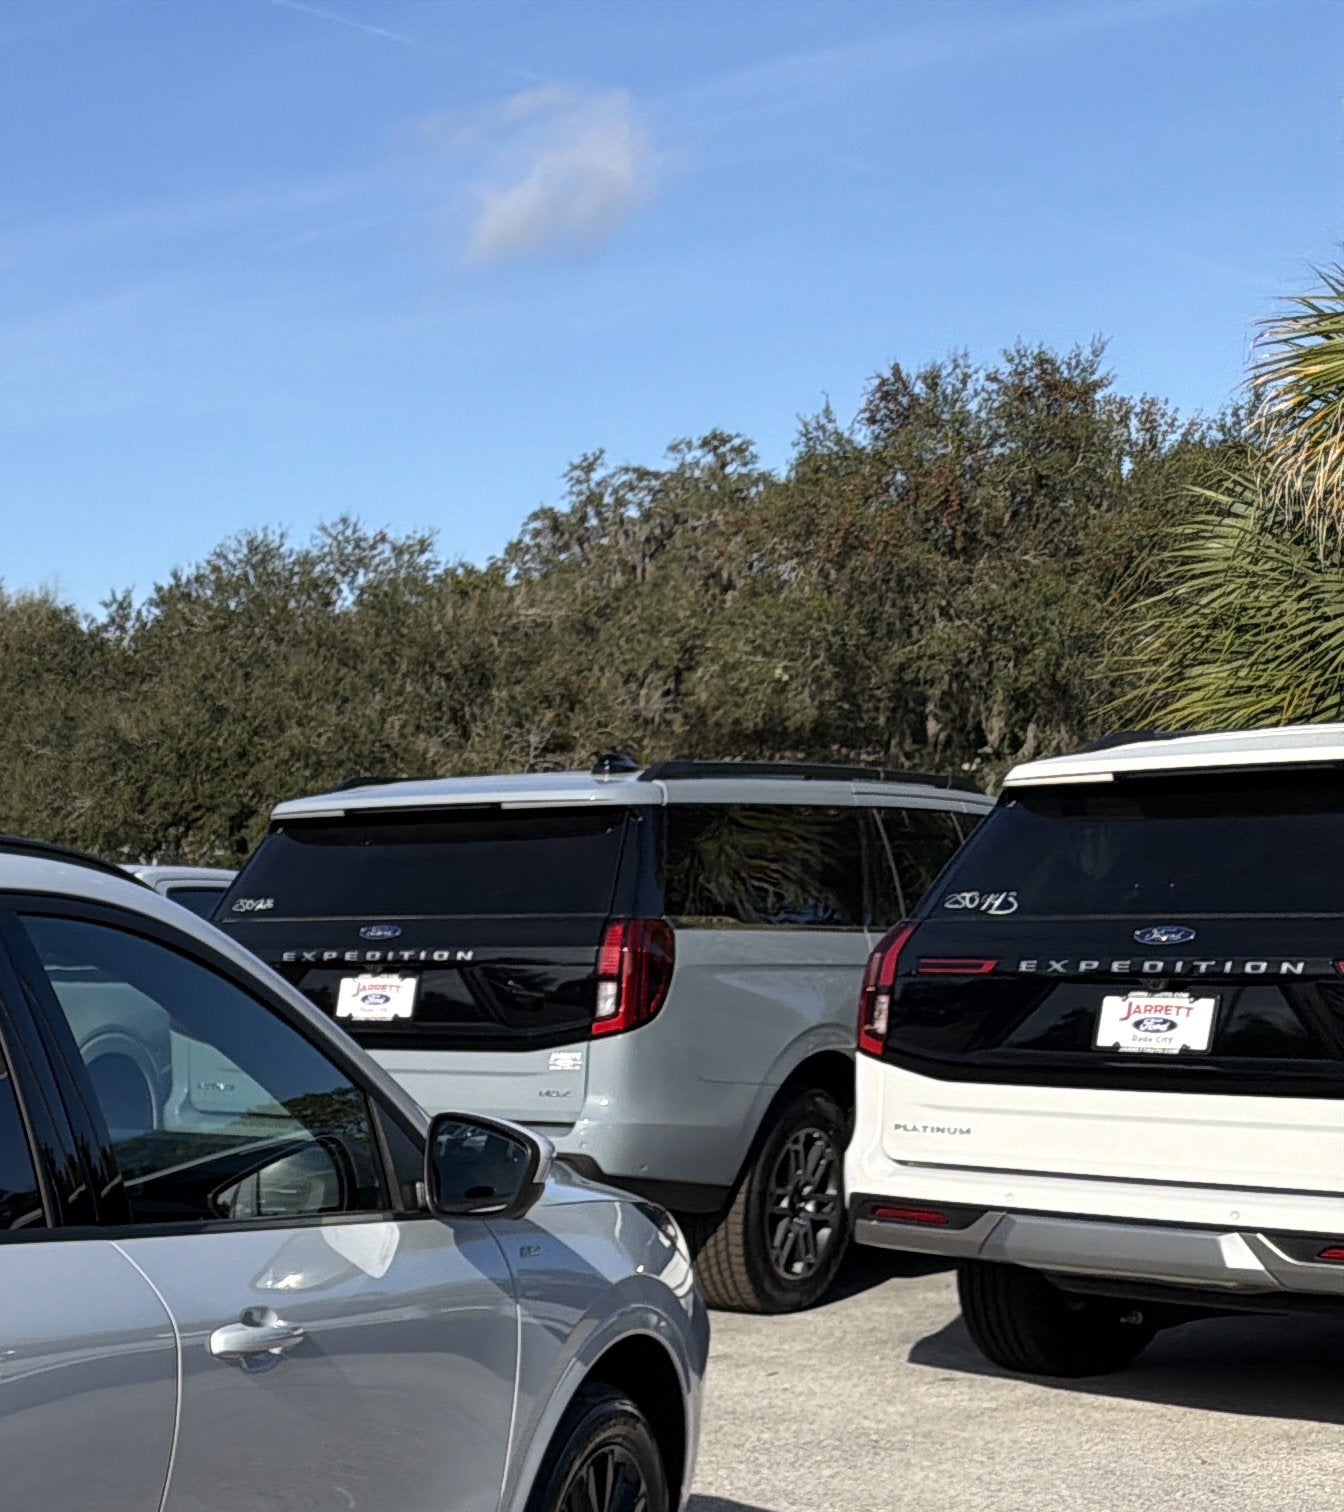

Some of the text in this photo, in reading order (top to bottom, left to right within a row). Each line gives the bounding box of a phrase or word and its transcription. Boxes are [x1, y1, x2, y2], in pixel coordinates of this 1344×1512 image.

[282, 950, 474, 962] EXPEDITION
[1018, 959, 1305, 975] EXPEDITION
[1119, 1001, 1194, 1021] JARRETT
[894, 1123, 971, 1135] PLATINUM
